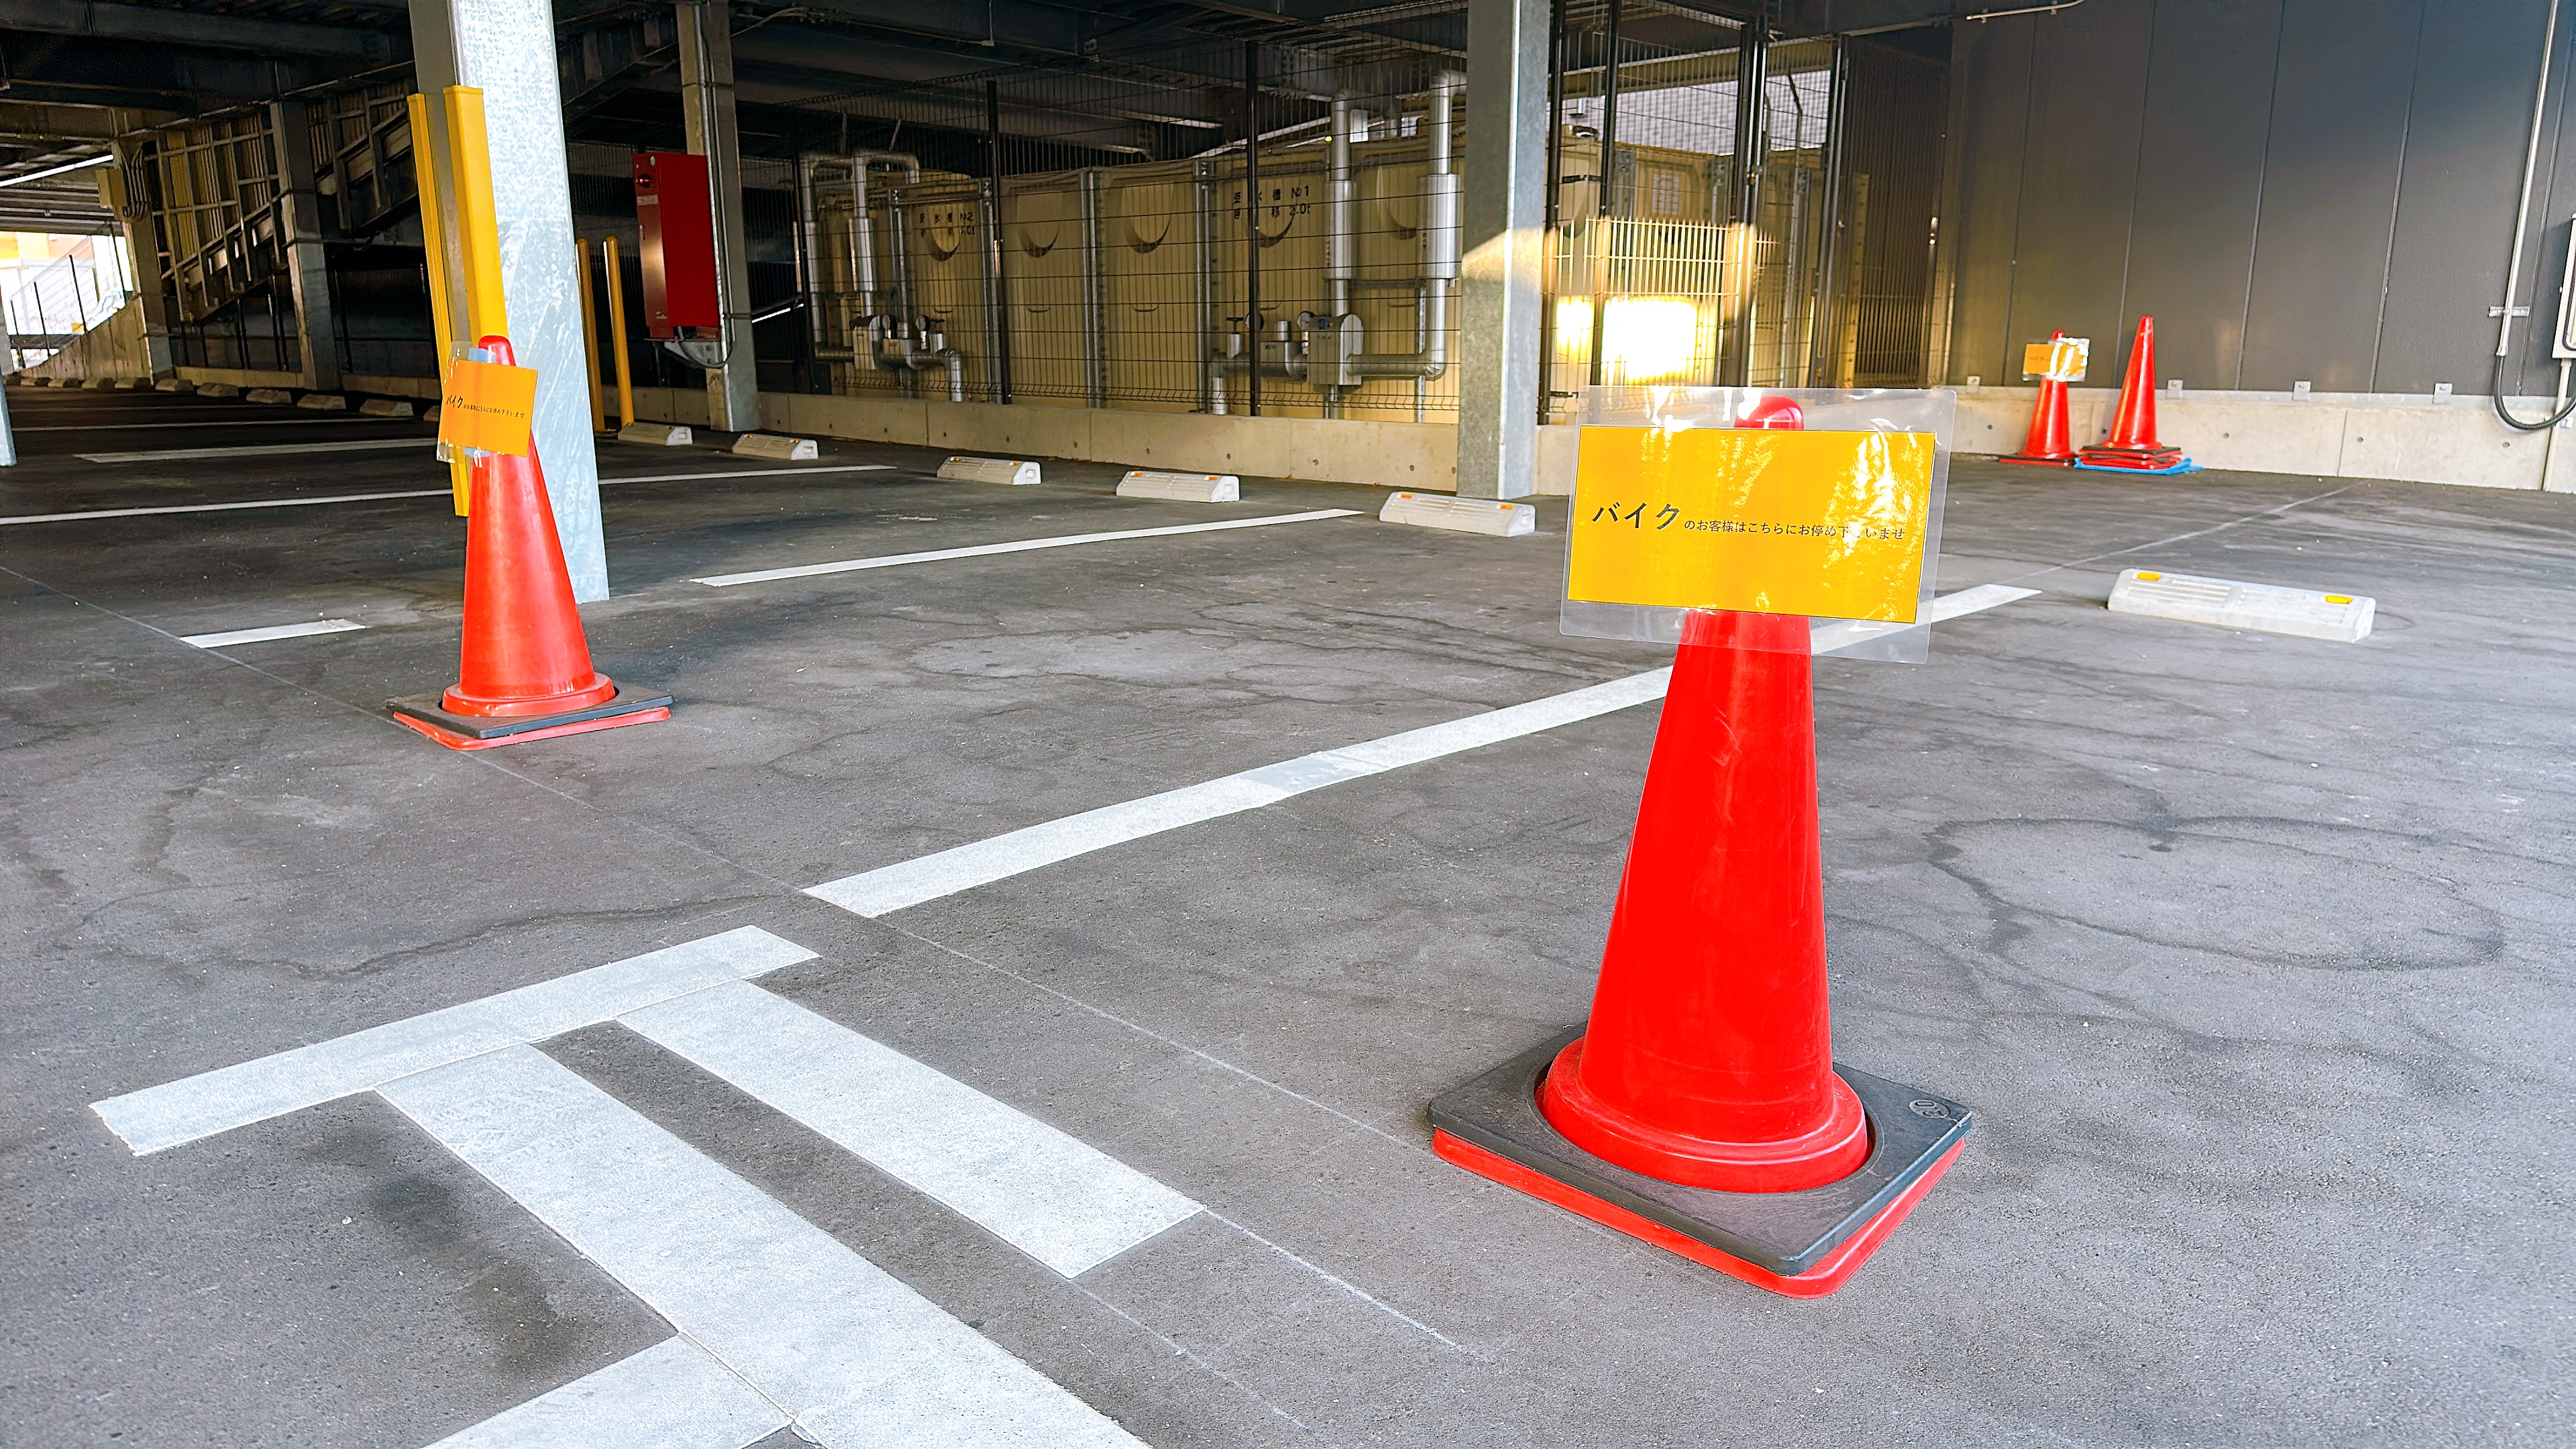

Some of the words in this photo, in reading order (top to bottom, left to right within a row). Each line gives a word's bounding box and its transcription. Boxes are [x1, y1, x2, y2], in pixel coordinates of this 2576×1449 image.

[1591, 501, 1906, 540] バイクのお客様はこちらにお停め下いませ
